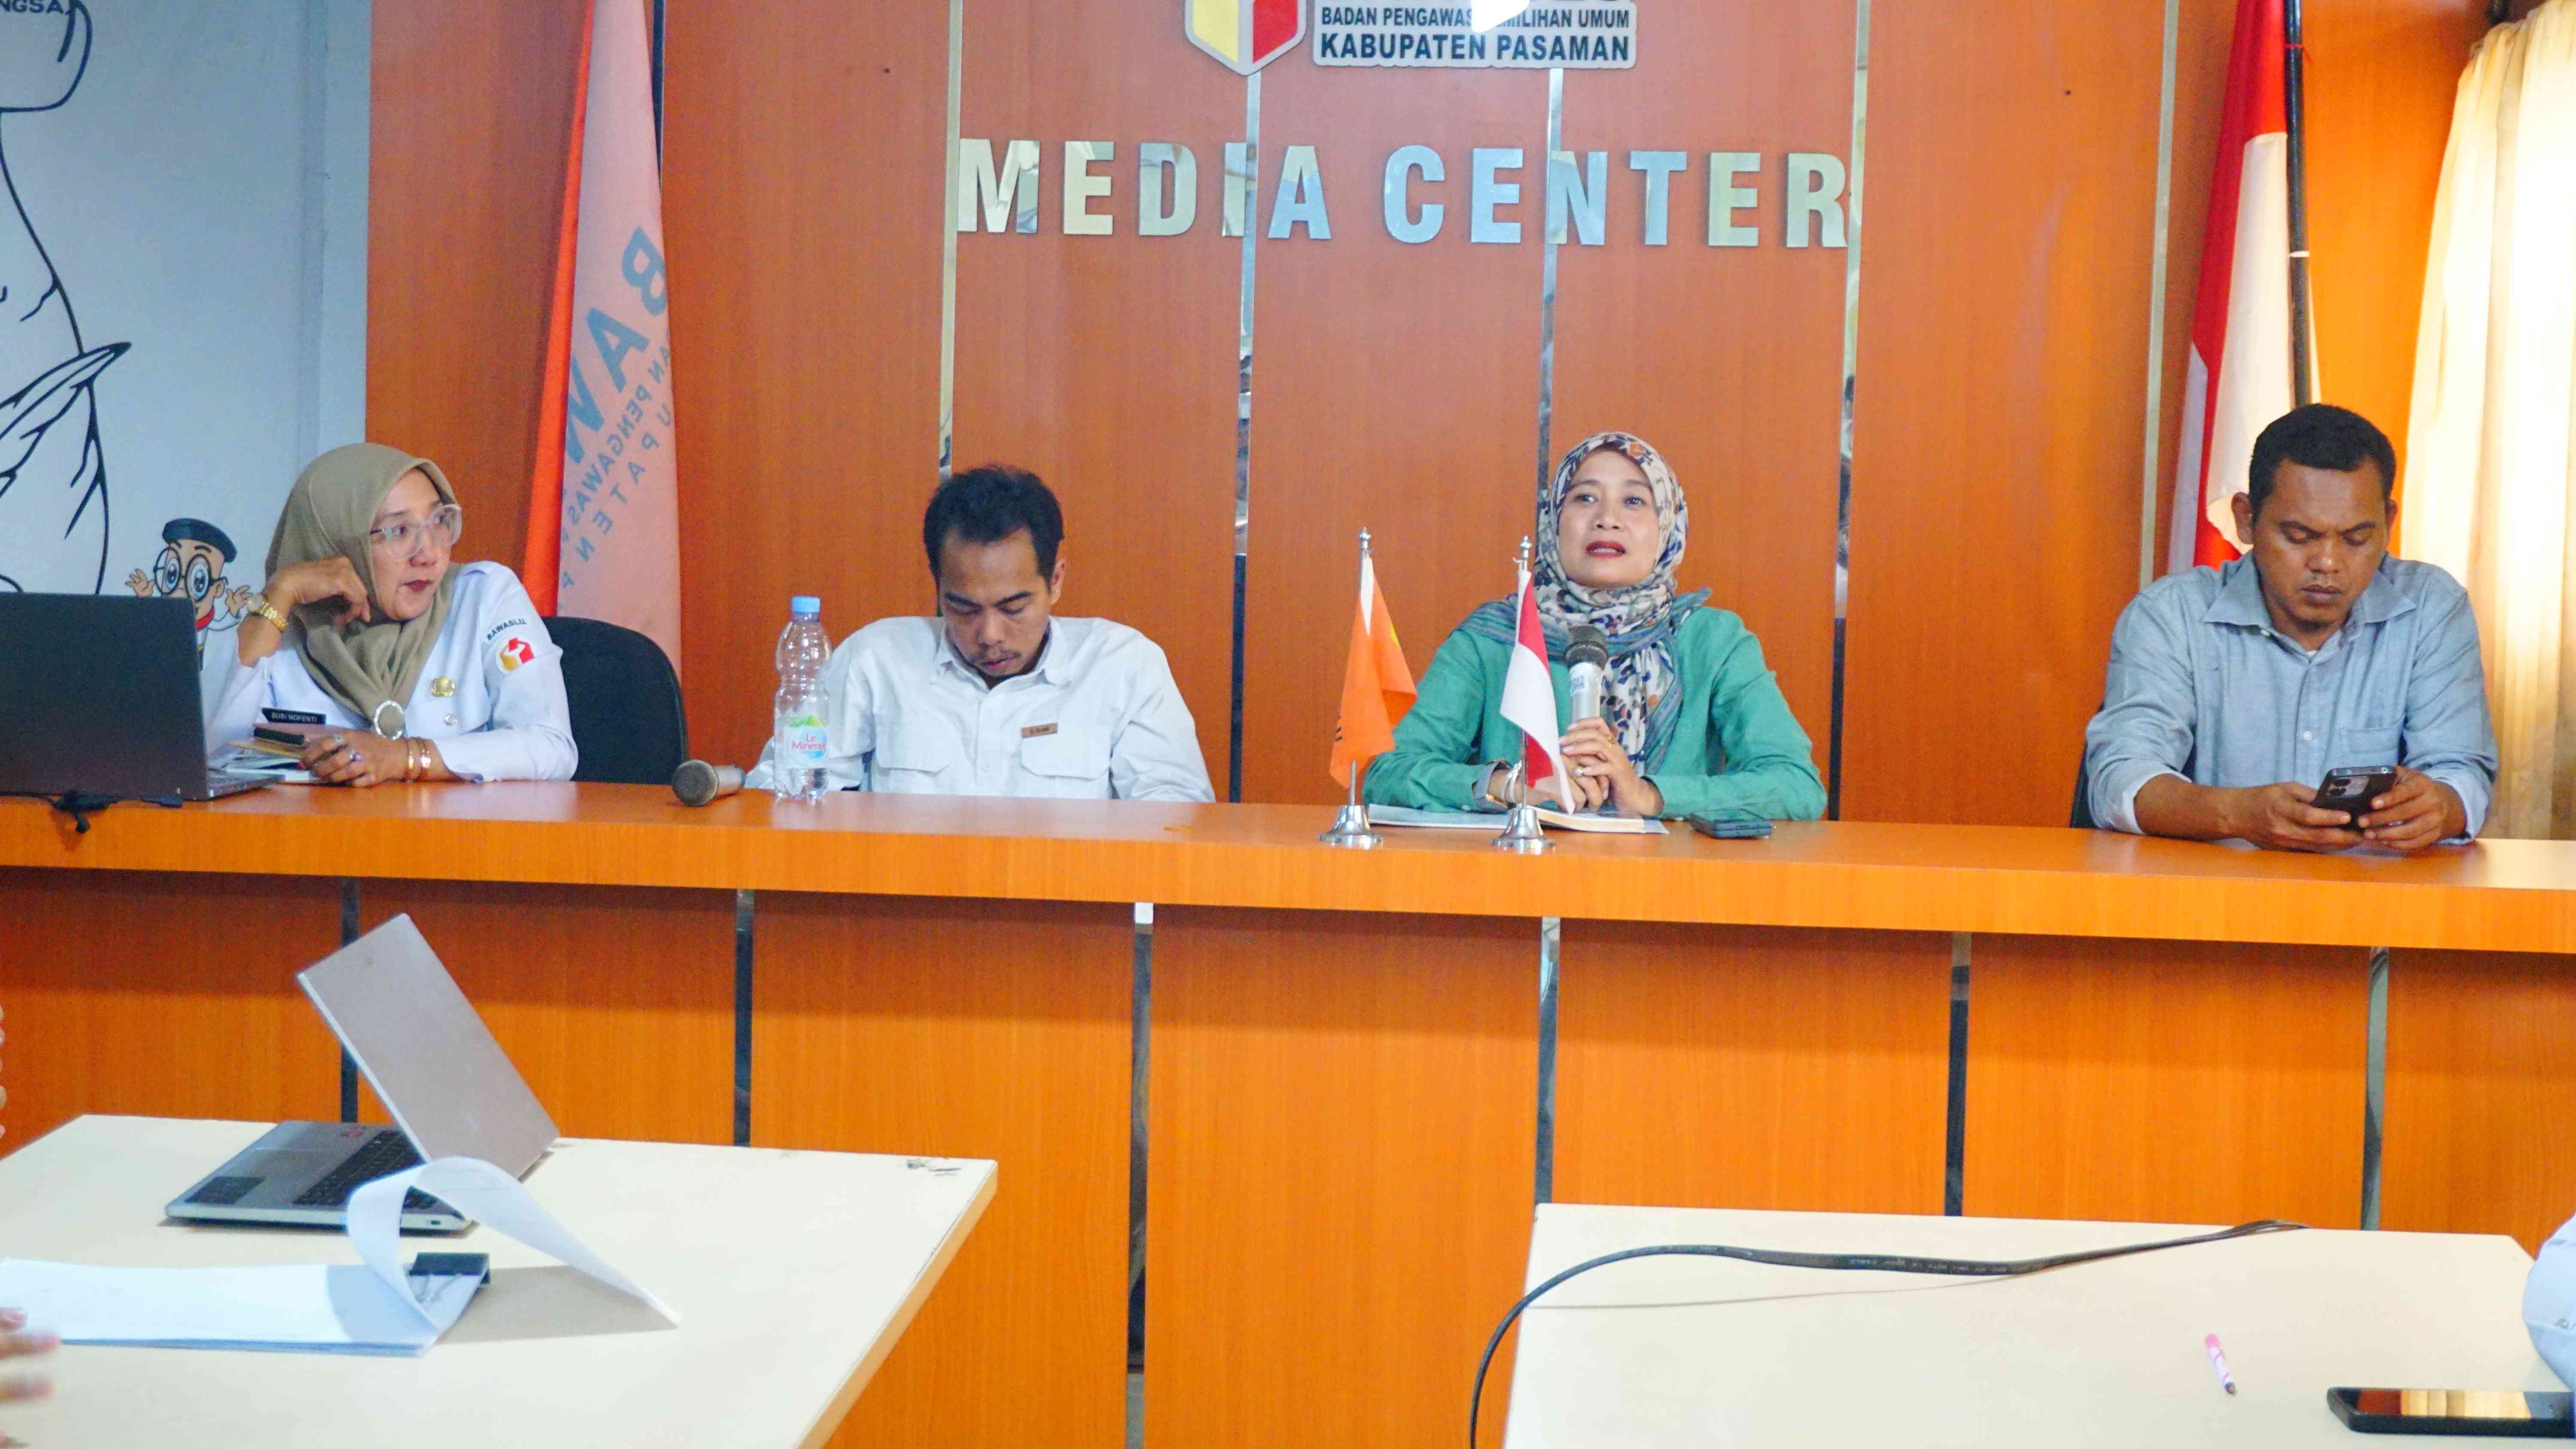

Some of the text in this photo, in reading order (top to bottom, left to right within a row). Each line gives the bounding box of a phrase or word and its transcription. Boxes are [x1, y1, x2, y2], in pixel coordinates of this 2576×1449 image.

[1322, 7, 1376, 25] BADAN
[1383, 8, 1472, 27] PENGAWAS
[1579, 9, 1629, 28] UMUM
[1321, 33, 1629, 61] KABUPATEN PASAMAN
[957, 139, 1848, 248] MEDIA CENTER
[486, 618, 527, 641] BAWASLU
[806, 733, 816, 742] Le
